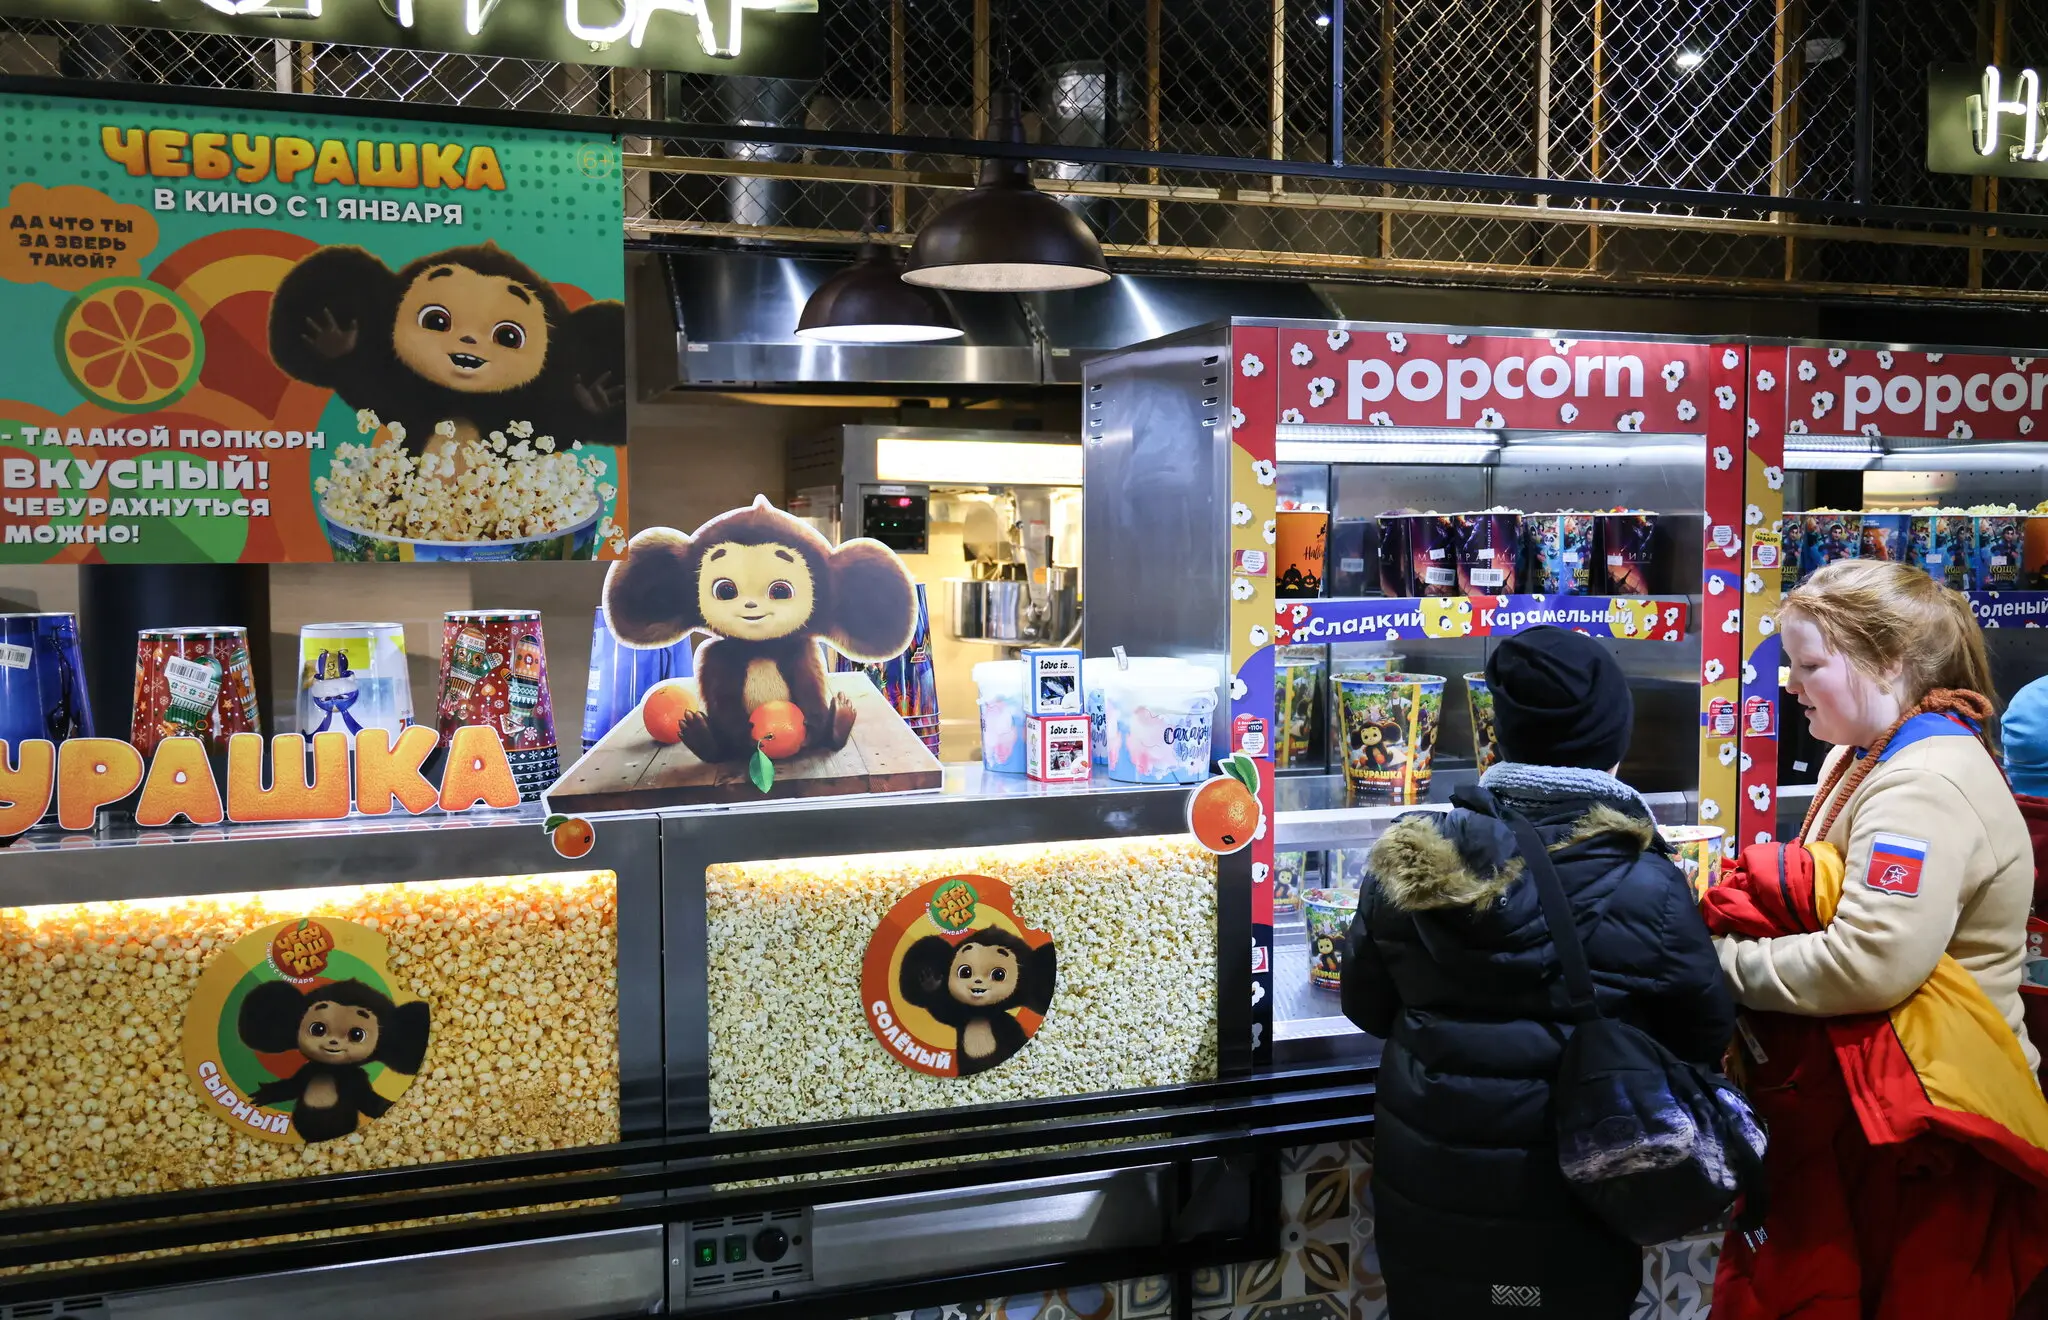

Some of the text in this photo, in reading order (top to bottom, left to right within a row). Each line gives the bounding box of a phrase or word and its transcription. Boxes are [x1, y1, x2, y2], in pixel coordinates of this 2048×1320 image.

[101, 126, 506, 191] ЧЕБУРАШКА
[583, 150, 610, 169] 6+
[154, 188, 463, 225] В КИНО С 1 ЯНВАРЯ
[10, 214, 133, 233] ДА ЧТО ТЫ
[18, 233, 126, 251] ЗА ЗВЕРЬ
[29, 252, 117, 269] ТАКОЙ?
[1347, 355, 1645, 420] popcorn
[21, 425, 170, 447] ТАААКОЙ
[179, 429, 326, 449] ПОПКОРН
[2, 454, 271, 490] ВКУСНЫЙ!
[3, 497, 271, 518] ЧЕБУРАХНУТЬСЯ
[4, 524, 140, 545] МОЖНО!
[1481, 606, 1633, 628] Карамельный
[1970, 597, 2048, 618] Соленый
[1309, 608, 1425, 637] Сладкий
[1040, 660, 1059, 670] love
[1050, 725, 1068, 735] love
[275, 926, 321, 951] ЧЕБУ
[281, 937, 329, 967] РАШ
[871, 1000, 952, 1070] СОЛЁНЫЙ
[198, 1060, 290, 1135] СЫРНЫЙ
